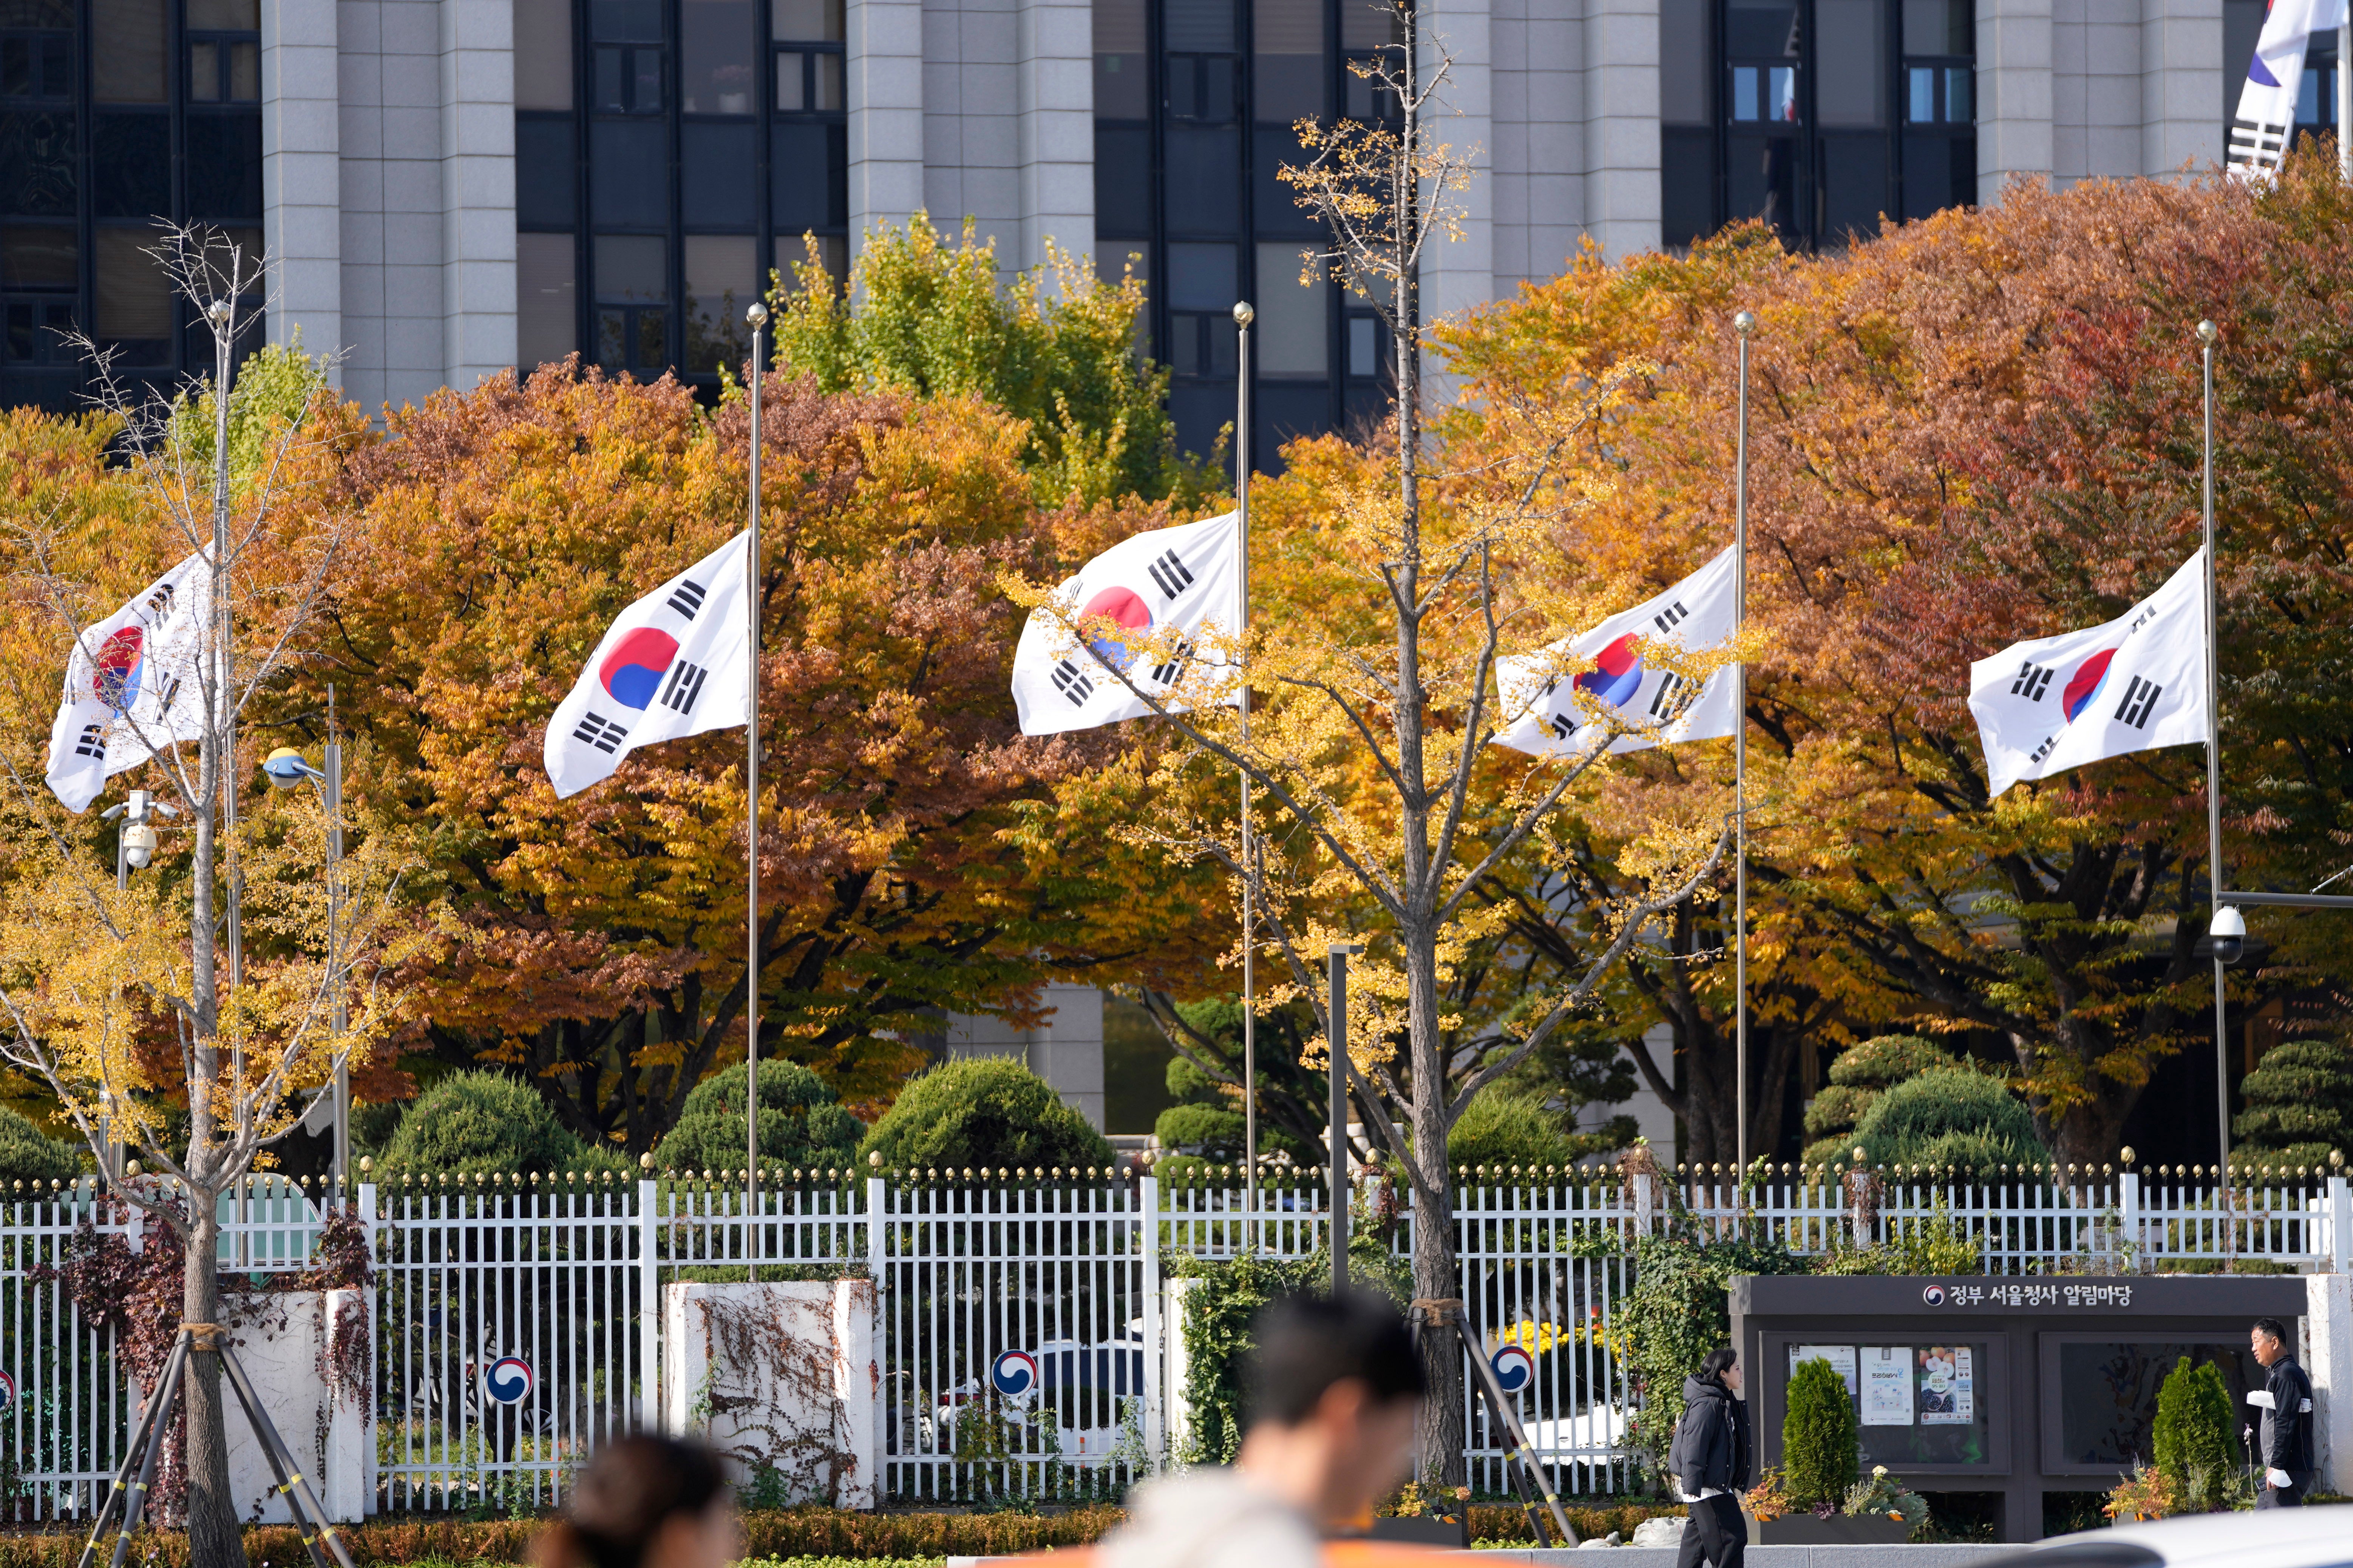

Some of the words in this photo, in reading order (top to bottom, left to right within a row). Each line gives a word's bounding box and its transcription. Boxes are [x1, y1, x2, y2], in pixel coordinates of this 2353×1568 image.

[1950, 1285, 1984, 1306] 정부
[1989, 1285, 2059, 1306] 서울청사
[2063, 1285, 2133, 1306] 알림마당
